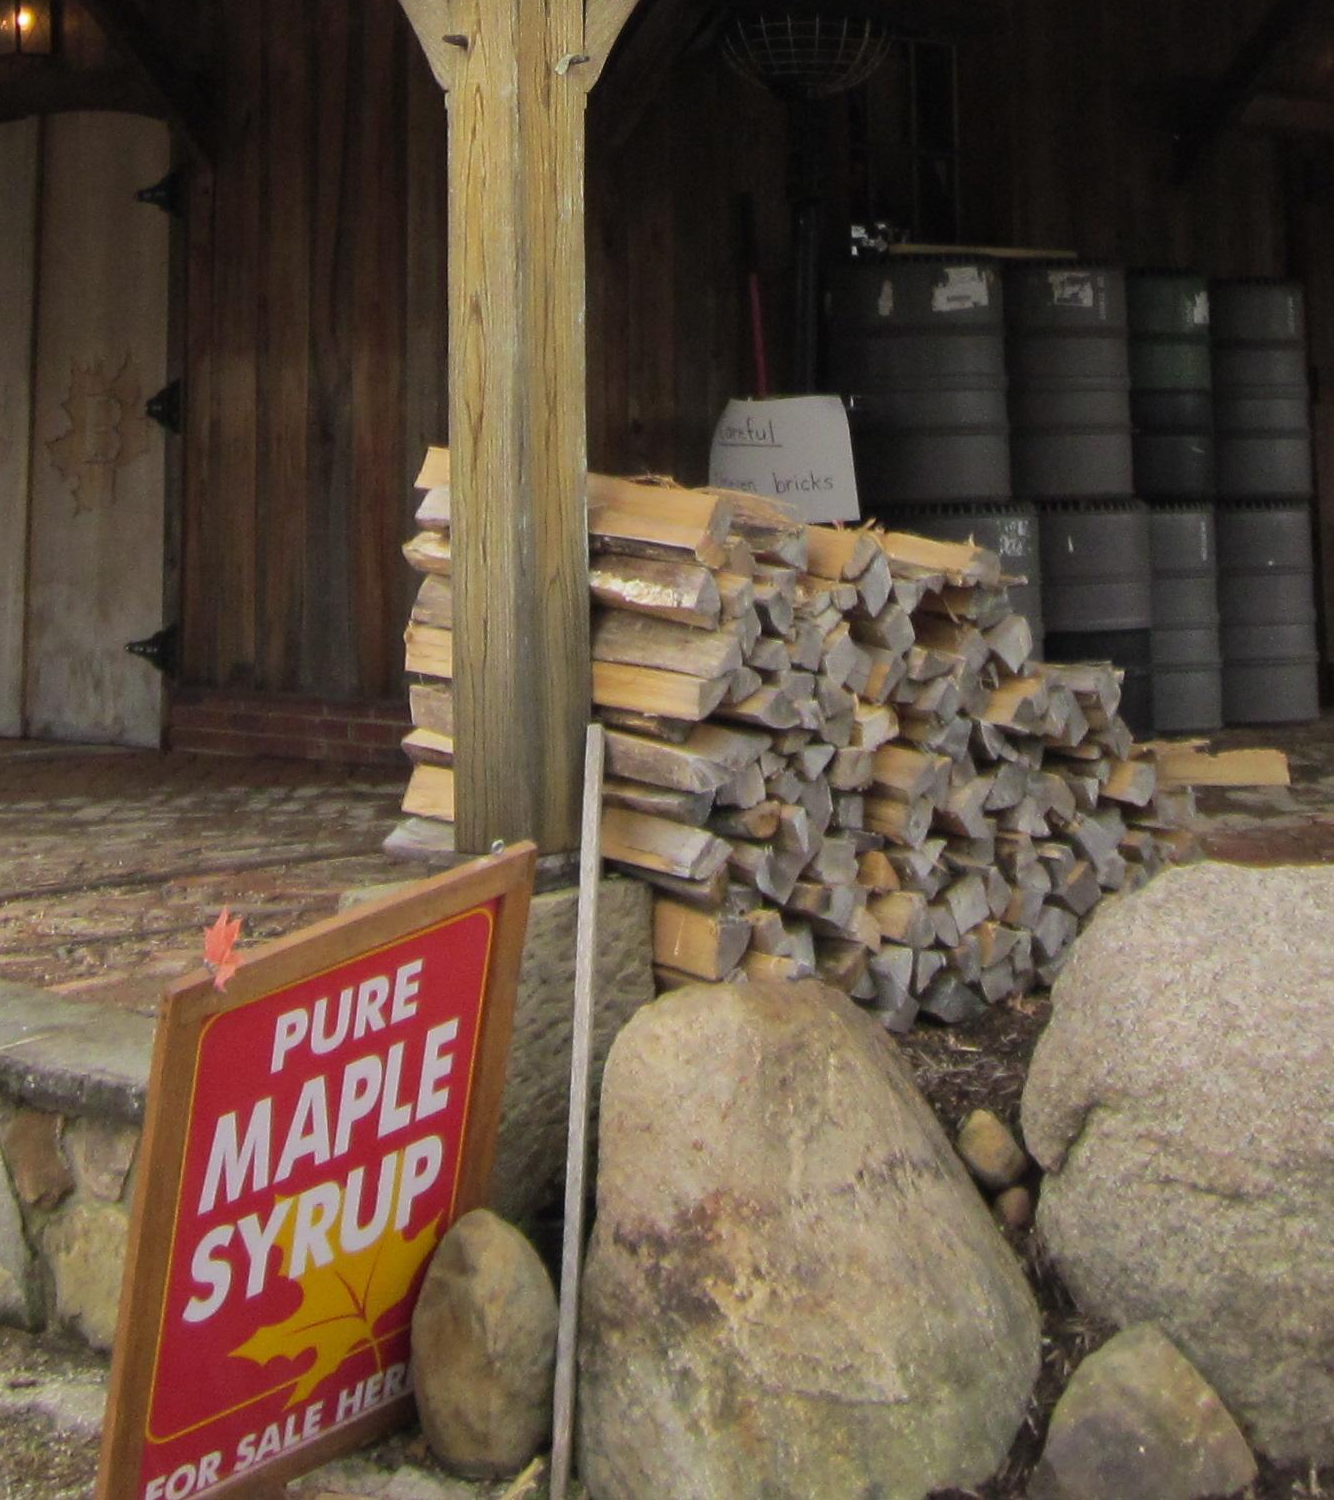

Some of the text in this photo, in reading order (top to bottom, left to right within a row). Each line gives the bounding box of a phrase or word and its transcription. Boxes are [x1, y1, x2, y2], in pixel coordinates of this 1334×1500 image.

[772, 470, 834, 495] bricks
[270, 958, 424, 1074] PURE
[197, 1018, 460, 1216] MAPLE
[182, 1135, 444, 1324] SYRUP
[144, 1451, 222, 1500] FOR
[233, 1401, 324, 1472] SALE
